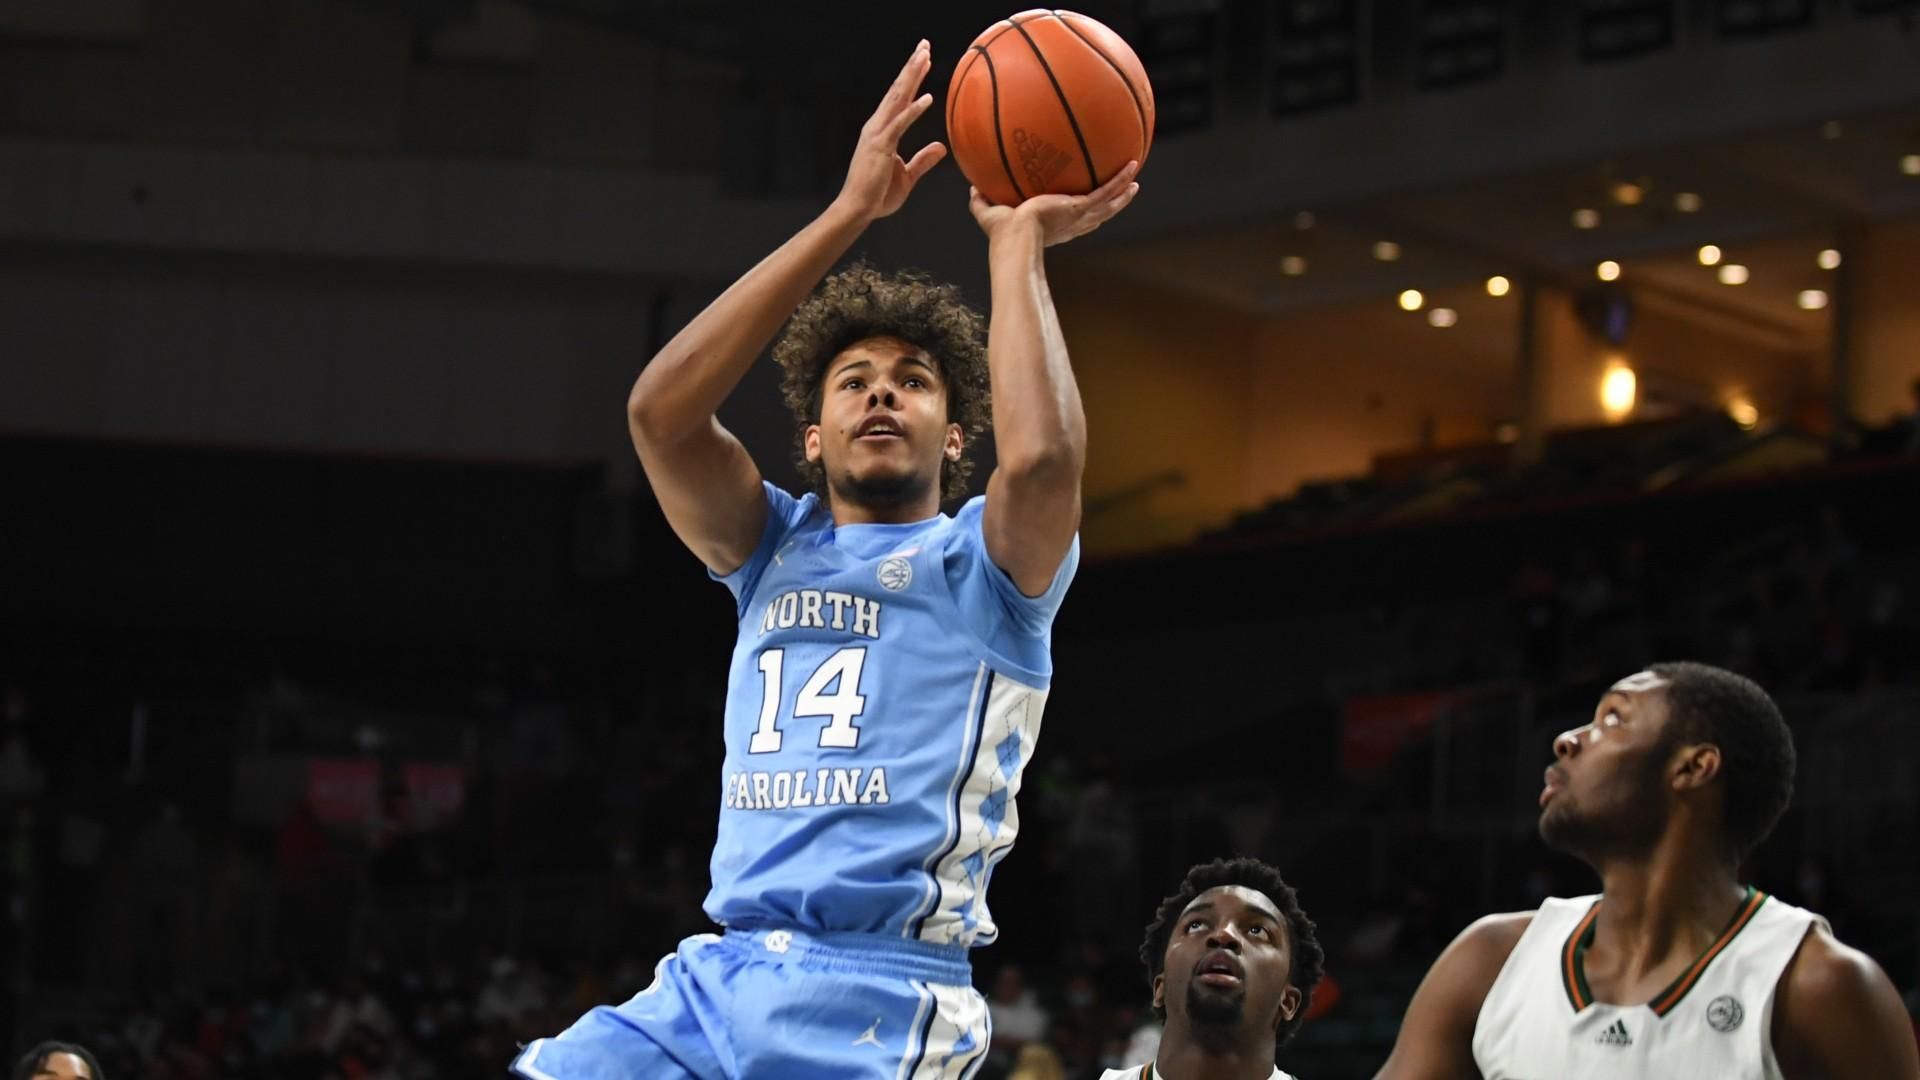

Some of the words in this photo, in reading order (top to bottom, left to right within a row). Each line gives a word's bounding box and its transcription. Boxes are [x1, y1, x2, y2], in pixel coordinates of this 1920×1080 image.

[758, 590, 880, 640] NORTH
[748, 647, 868, 754] 14
[726, 767, 890, 810] CAROLINA
